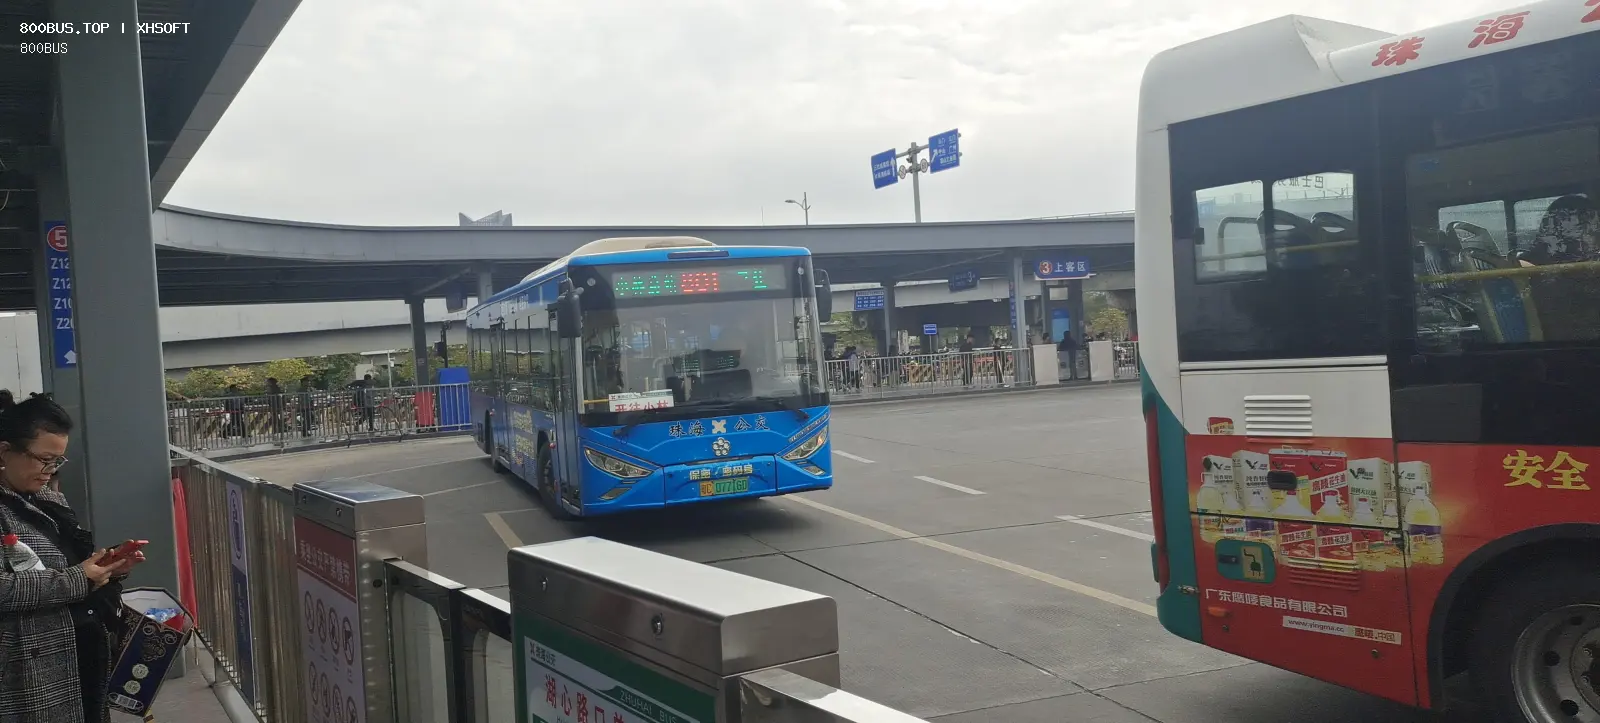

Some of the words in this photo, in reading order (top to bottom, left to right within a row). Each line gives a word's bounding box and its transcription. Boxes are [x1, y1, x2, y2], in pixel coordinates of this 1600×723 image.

[55, 230, 68, 248] 5
[1042, 261, 1050, 274] 3
[1054, 260, 1086, 273] 上客区
[669, 419, 707, 439] 珠海
[734, 414, 770, 432] 公交
[1502, 449, 1591, 491] 安全
[1205, 588, 1348, 618] 广东鹰唛食品有限公司
[619, 690, 653, 715] ZHUHAI
[659, 709, 678, 723] BUS
